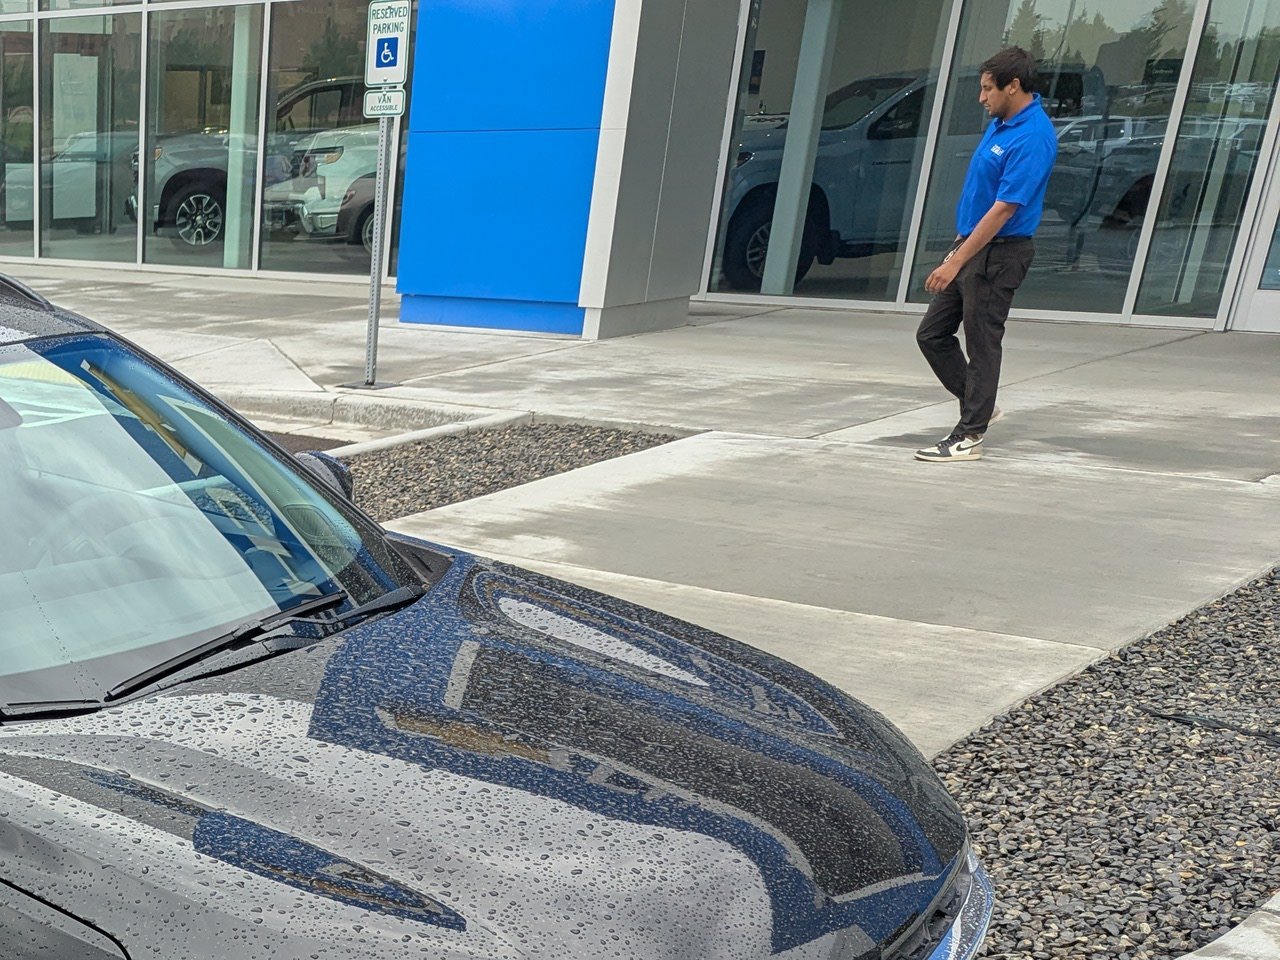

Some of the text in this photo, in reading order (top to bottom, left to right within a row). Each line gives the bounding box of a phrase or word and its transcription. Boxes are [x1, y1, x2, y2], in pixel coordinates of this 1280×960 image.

[372, 7, 407, 20] RESERVED
[373, 22, 404, 34] PARKING
[377, 96, 392, 104] VAN
